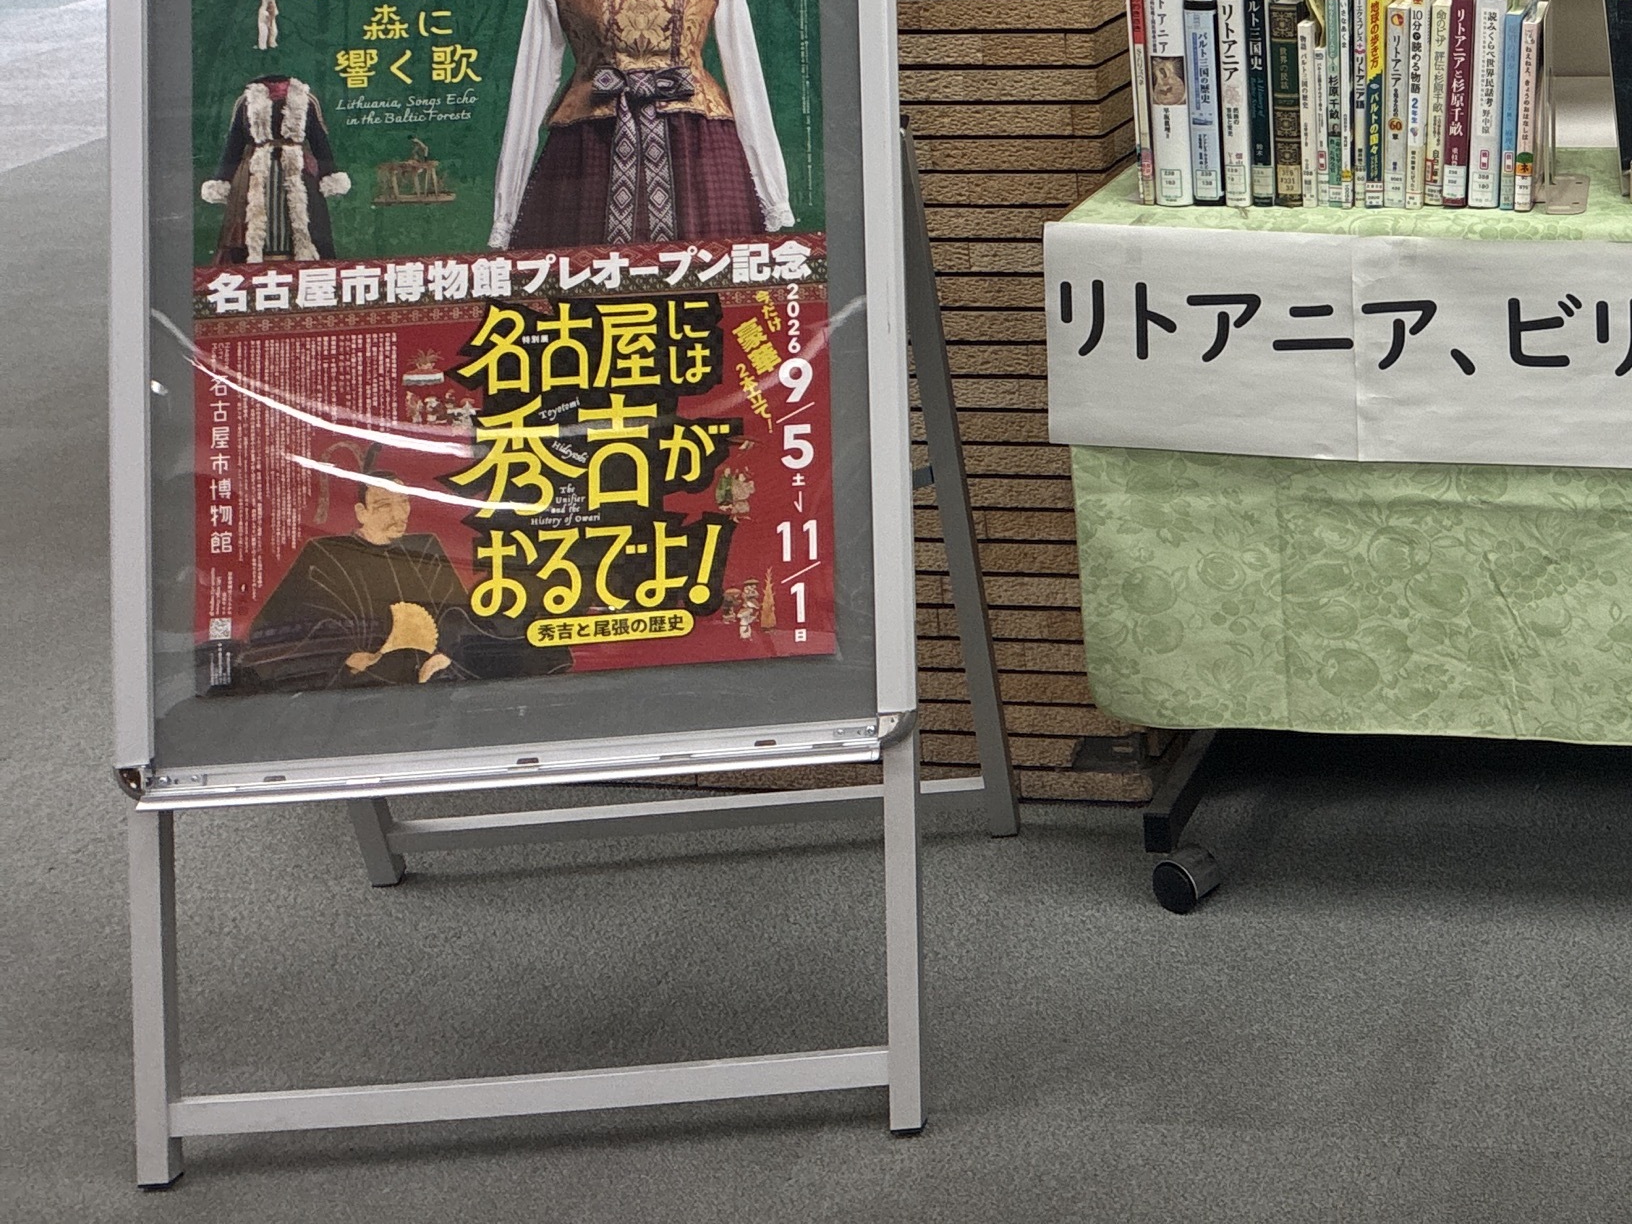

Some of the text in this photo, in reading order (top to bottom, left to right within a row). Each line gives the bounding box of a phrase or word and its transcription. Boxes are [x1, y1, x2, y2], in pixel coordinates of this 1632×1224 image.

[363, 4, 453, 40] 森に
[1221, 4, 1240, 82] リトアニア
[335, 44, 482, 88] 響く歌
[1449, 8, 1467, 137] リトアニアと杉原千畝
[1485, 11, 1498, 108] 読みくらべ世界民話考
[347, 108, 471, 125] in the Baltic Forests
[406, 95, 441, 112] Songs
[446, 88, 479, 105] Echo
[1328, 75, 1340, 120] 杉原千畝
[207, 238, 813, 315] 名古屋市博物館プレオープン記念
[732, 316, 783, 374] 豪華
[787, 282, 802, 354] 2026
[209, 374, 233, 554] 名古屋市博物館
[449, 393, 731, 518] 秀吉が
[530, 514, 562, 528] History
[471, 521, 722, 619] おるでよ!
[537, 614, 685, 642] 秀吉と尾張の歴史
